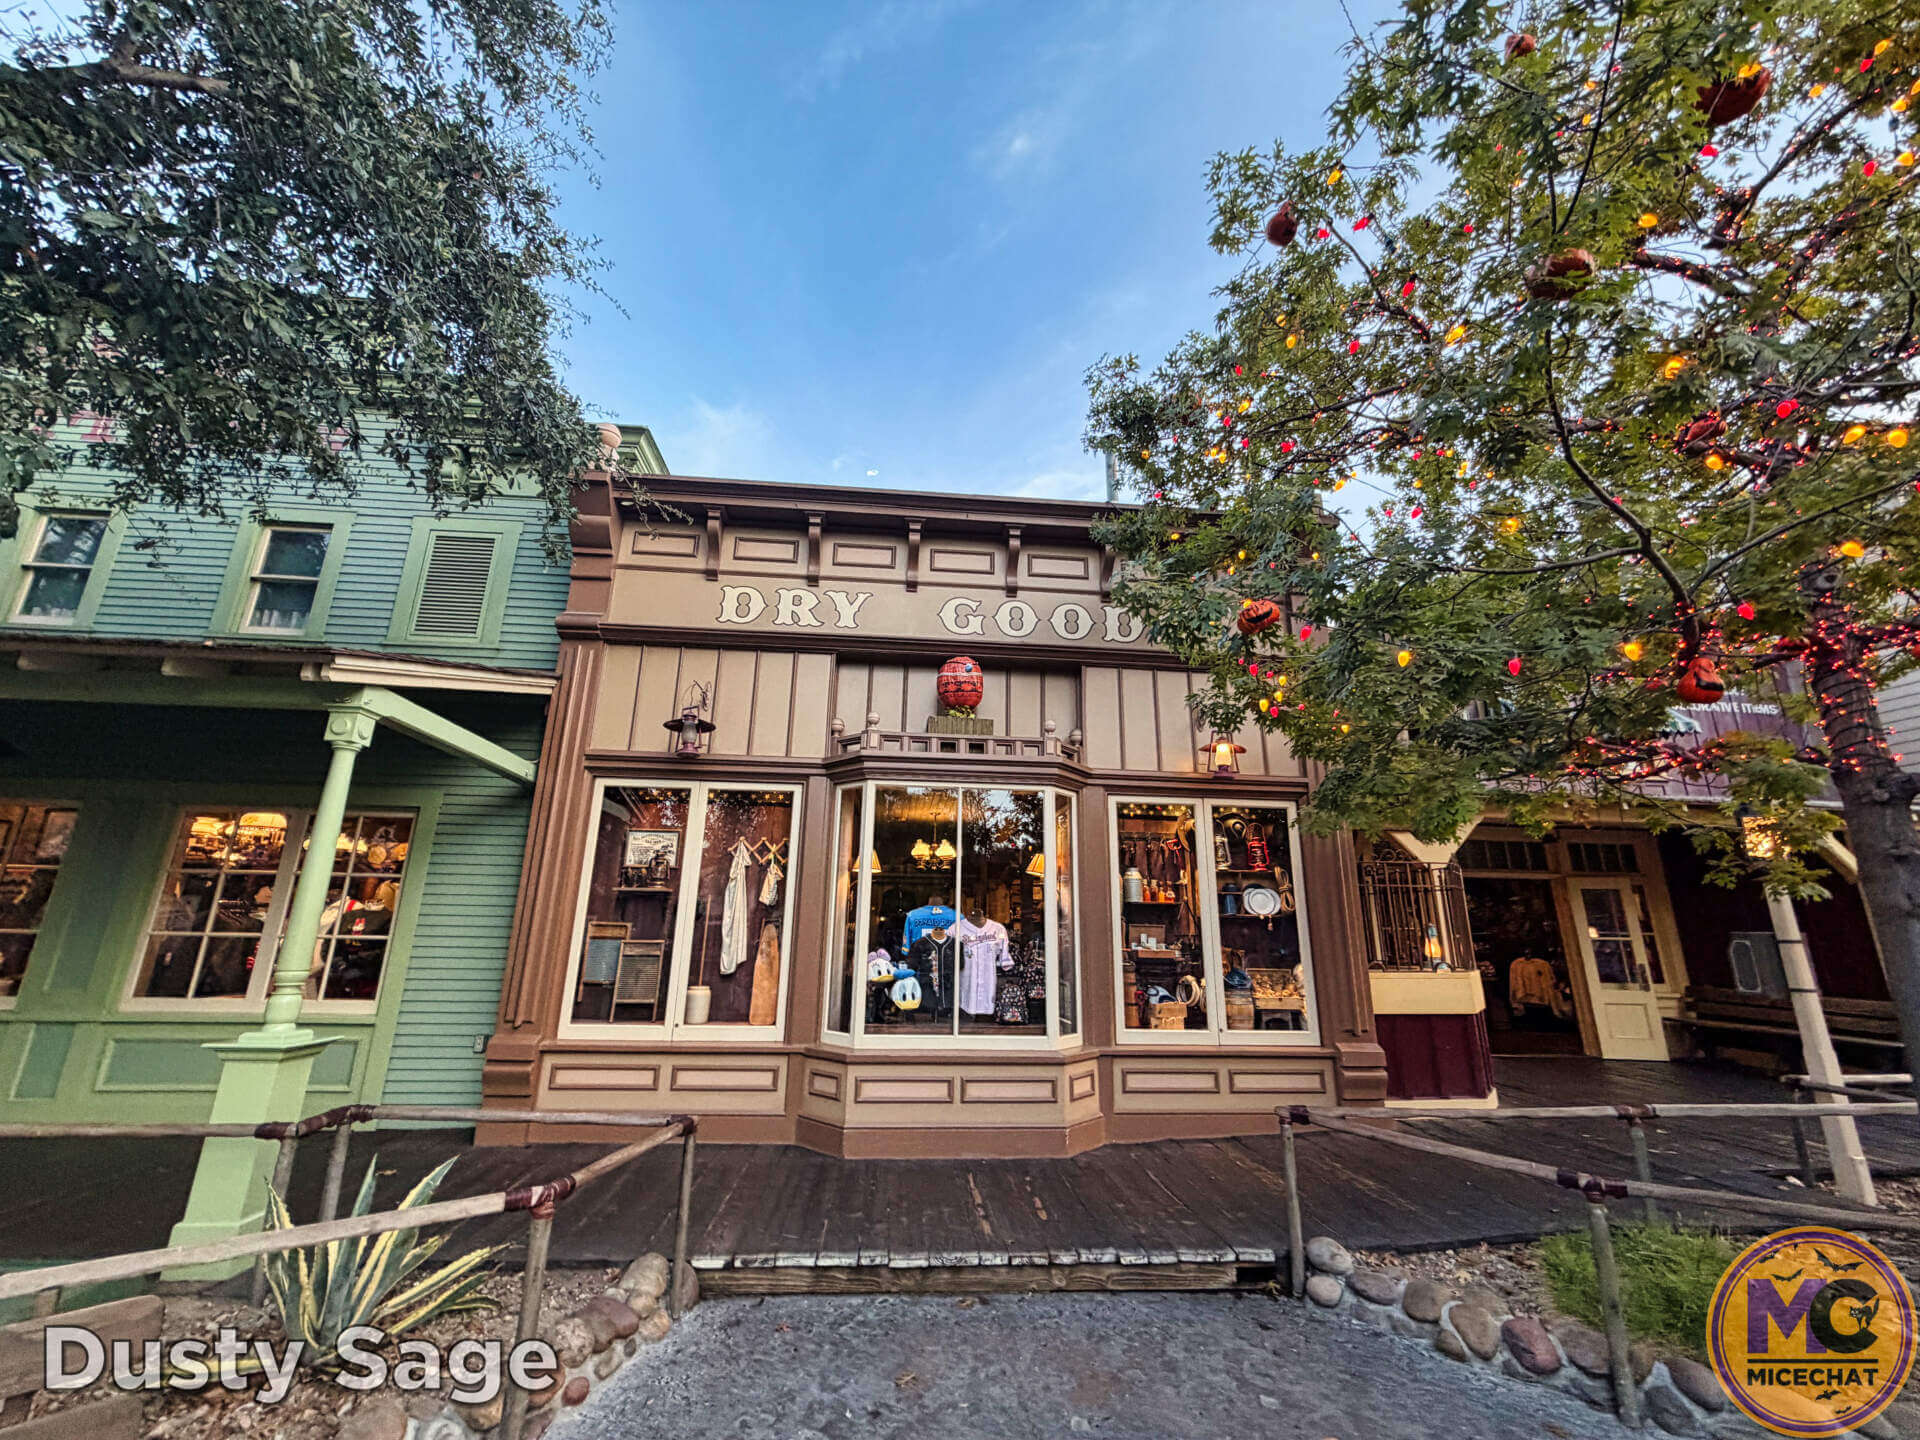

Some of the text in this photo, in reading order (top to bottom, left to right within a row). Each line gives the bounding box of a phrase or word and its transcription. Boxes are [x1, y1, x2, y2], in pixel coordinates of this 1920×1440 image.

[716, 585, 1148, 643] DRY GOOD
[1741, 703, 1778, 715] ITEMS
